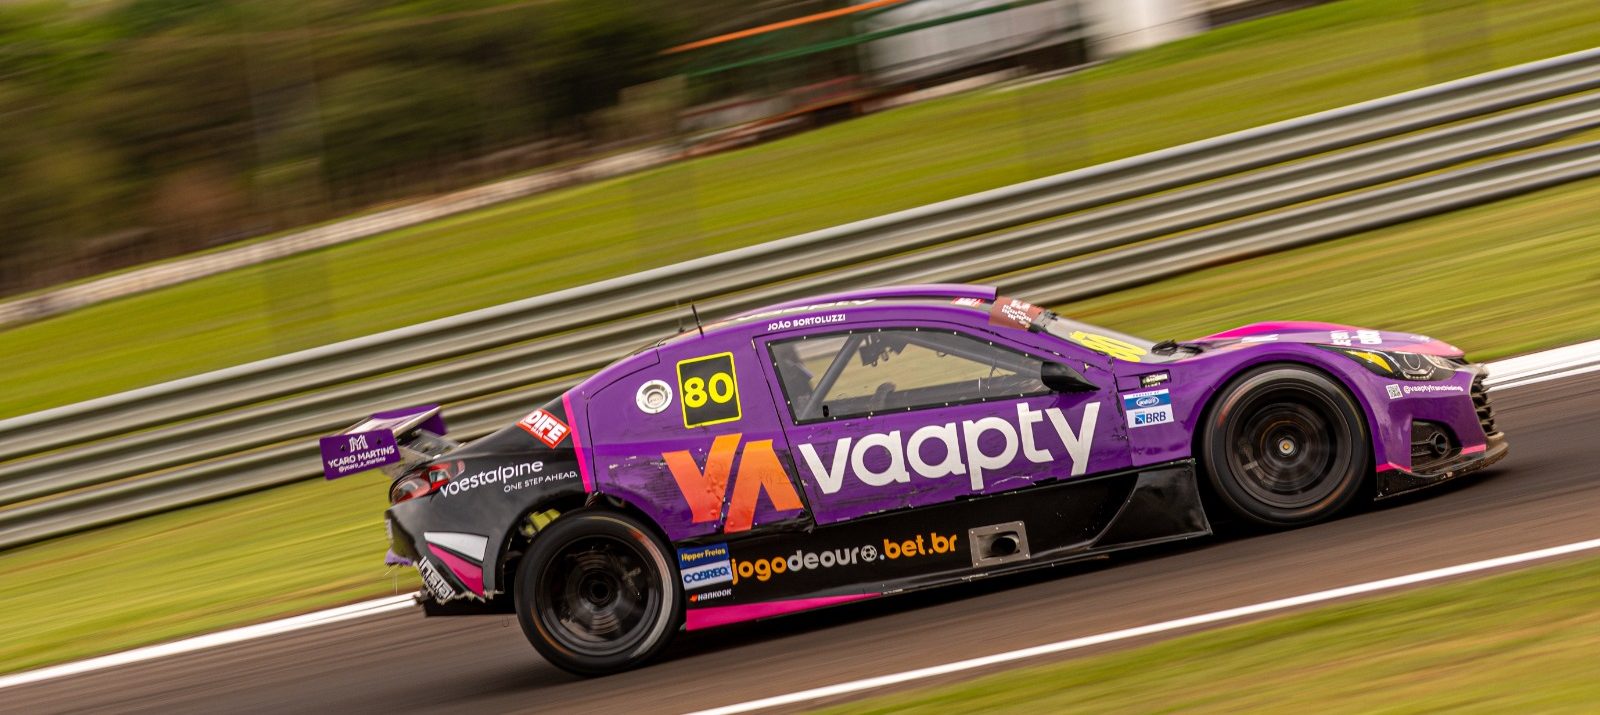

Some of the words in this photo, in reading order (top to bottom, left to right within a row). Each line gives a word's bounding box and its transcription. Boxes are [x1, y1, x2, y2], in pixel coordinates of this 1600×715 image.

[767, 320, 791, 331] JOÃO
[793, 313, 846, 327] BORTOLUZZI
[683, 372, 735, 408] 80
[519, 409, 567, 443] DIFE
[1146, 412, 1167, 424] BRB
[328, 454, 356, 468] YCARO
[357, 445, 395, 461] MARTINS
[797, 402, 1101, 495] vaapty
[440, 460, 543, 498] voestalpine
[503, 481, 522, 493] ONE
[524, 475, 544, 489] STEP
[681, 551, 704, 562] Hipper
[704, 547, 726, 558] Freios
[683, 566, 729, 584] COBREQ
